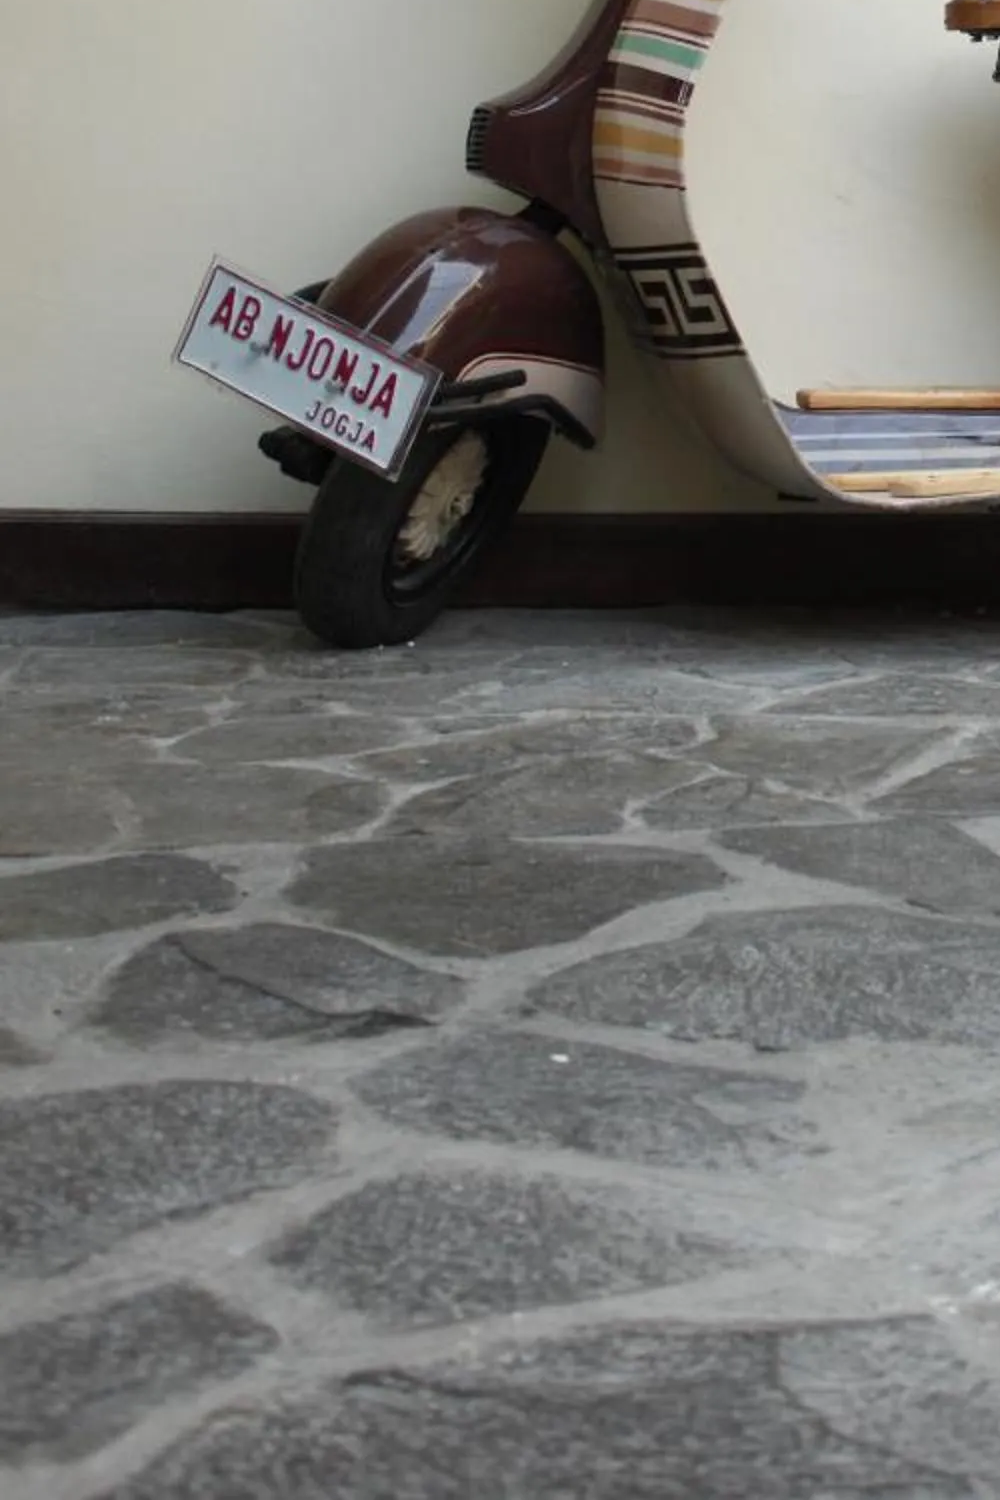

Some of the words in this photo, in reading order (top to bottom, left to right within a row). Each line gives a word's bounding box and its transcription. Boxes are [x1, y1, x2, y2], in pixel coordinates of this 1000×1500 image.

[208, 286, 261, 340] AB
[264, 313, 398, 419] NJONJA
[305, 401, 376, 452] JOGJA
